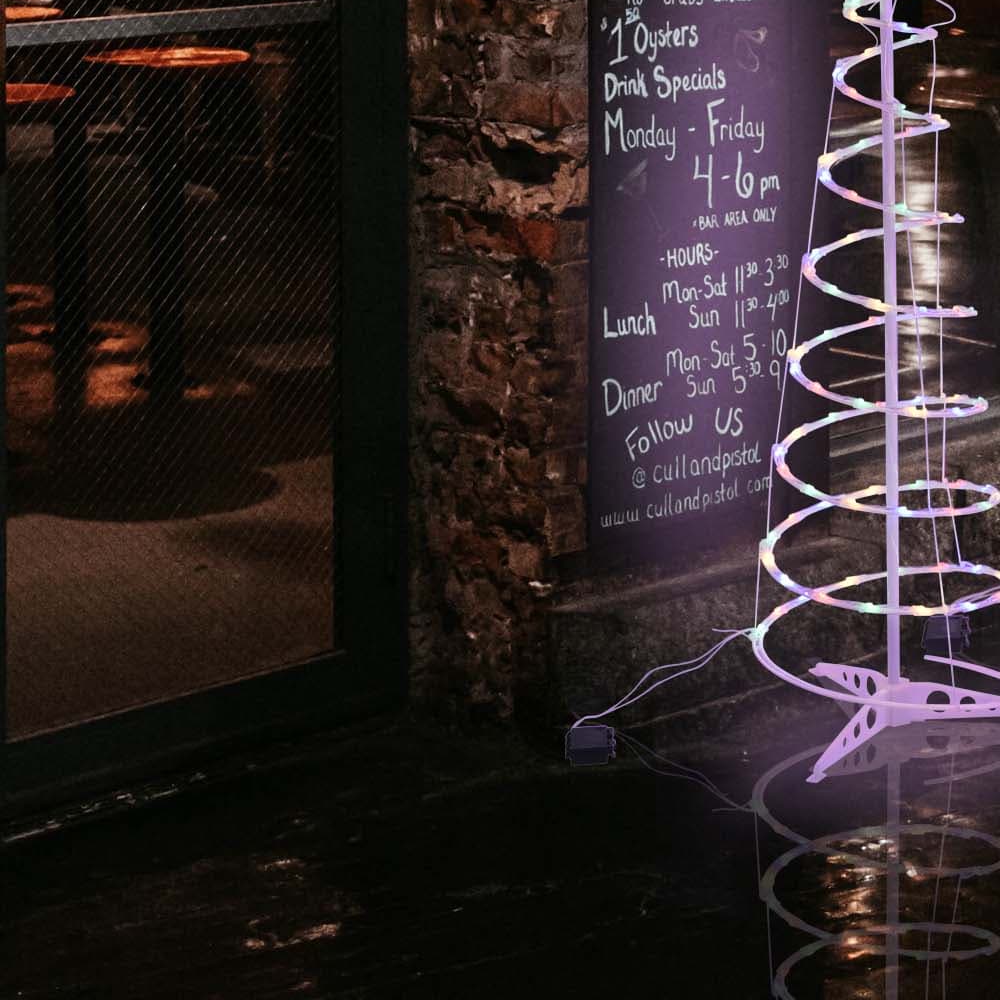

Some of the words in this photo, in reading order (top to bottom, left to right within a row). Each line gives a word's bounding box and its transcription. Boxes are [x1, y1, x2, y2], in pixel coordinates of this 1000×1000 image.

[633, 20, 699, 63] Oysters
[604, 68, 649, 103] Drink
[653, 62, 727, 104] Specials
[604, 106, 676, 161] Monday
[706, 97, 765, 153] Friday
[760, 174, 780, 201] pm
[724, 210, 749, 227] AREA
[752, 207, 777, 223] ONLY
[603, 300, 657, 339] Lunch
[688, 303, 720, 329] Sun
[602, 378, 664, 417] Dinner
[686, 374, 716, 398] Sun
[625, 413, 694, 462] Follow
[714, 407, 744, 437] US
